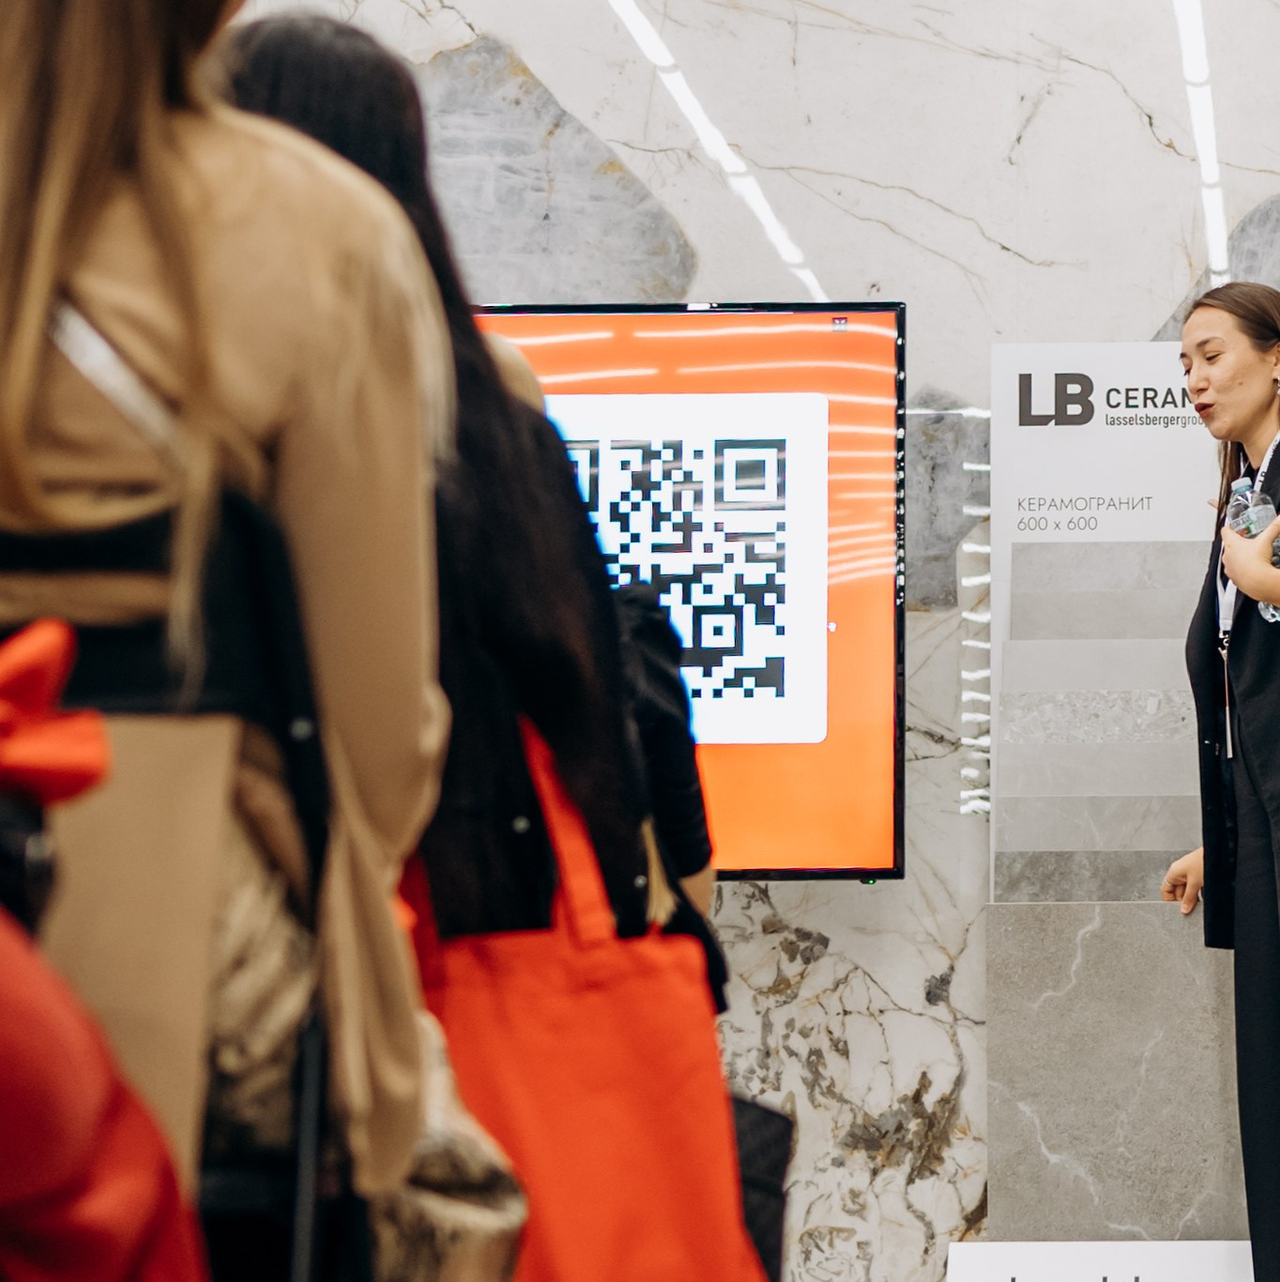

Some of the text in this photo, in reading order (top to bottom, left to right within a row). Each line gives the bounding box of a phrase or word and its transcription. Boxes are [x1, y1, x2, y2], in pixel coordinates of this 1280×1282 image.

[1018, 372, 1095, 426] LB
[1017, 496, 1153, 512] КЕРАМОГРАНИТ
[1017, 516, 1098, 531] 600 x 600
